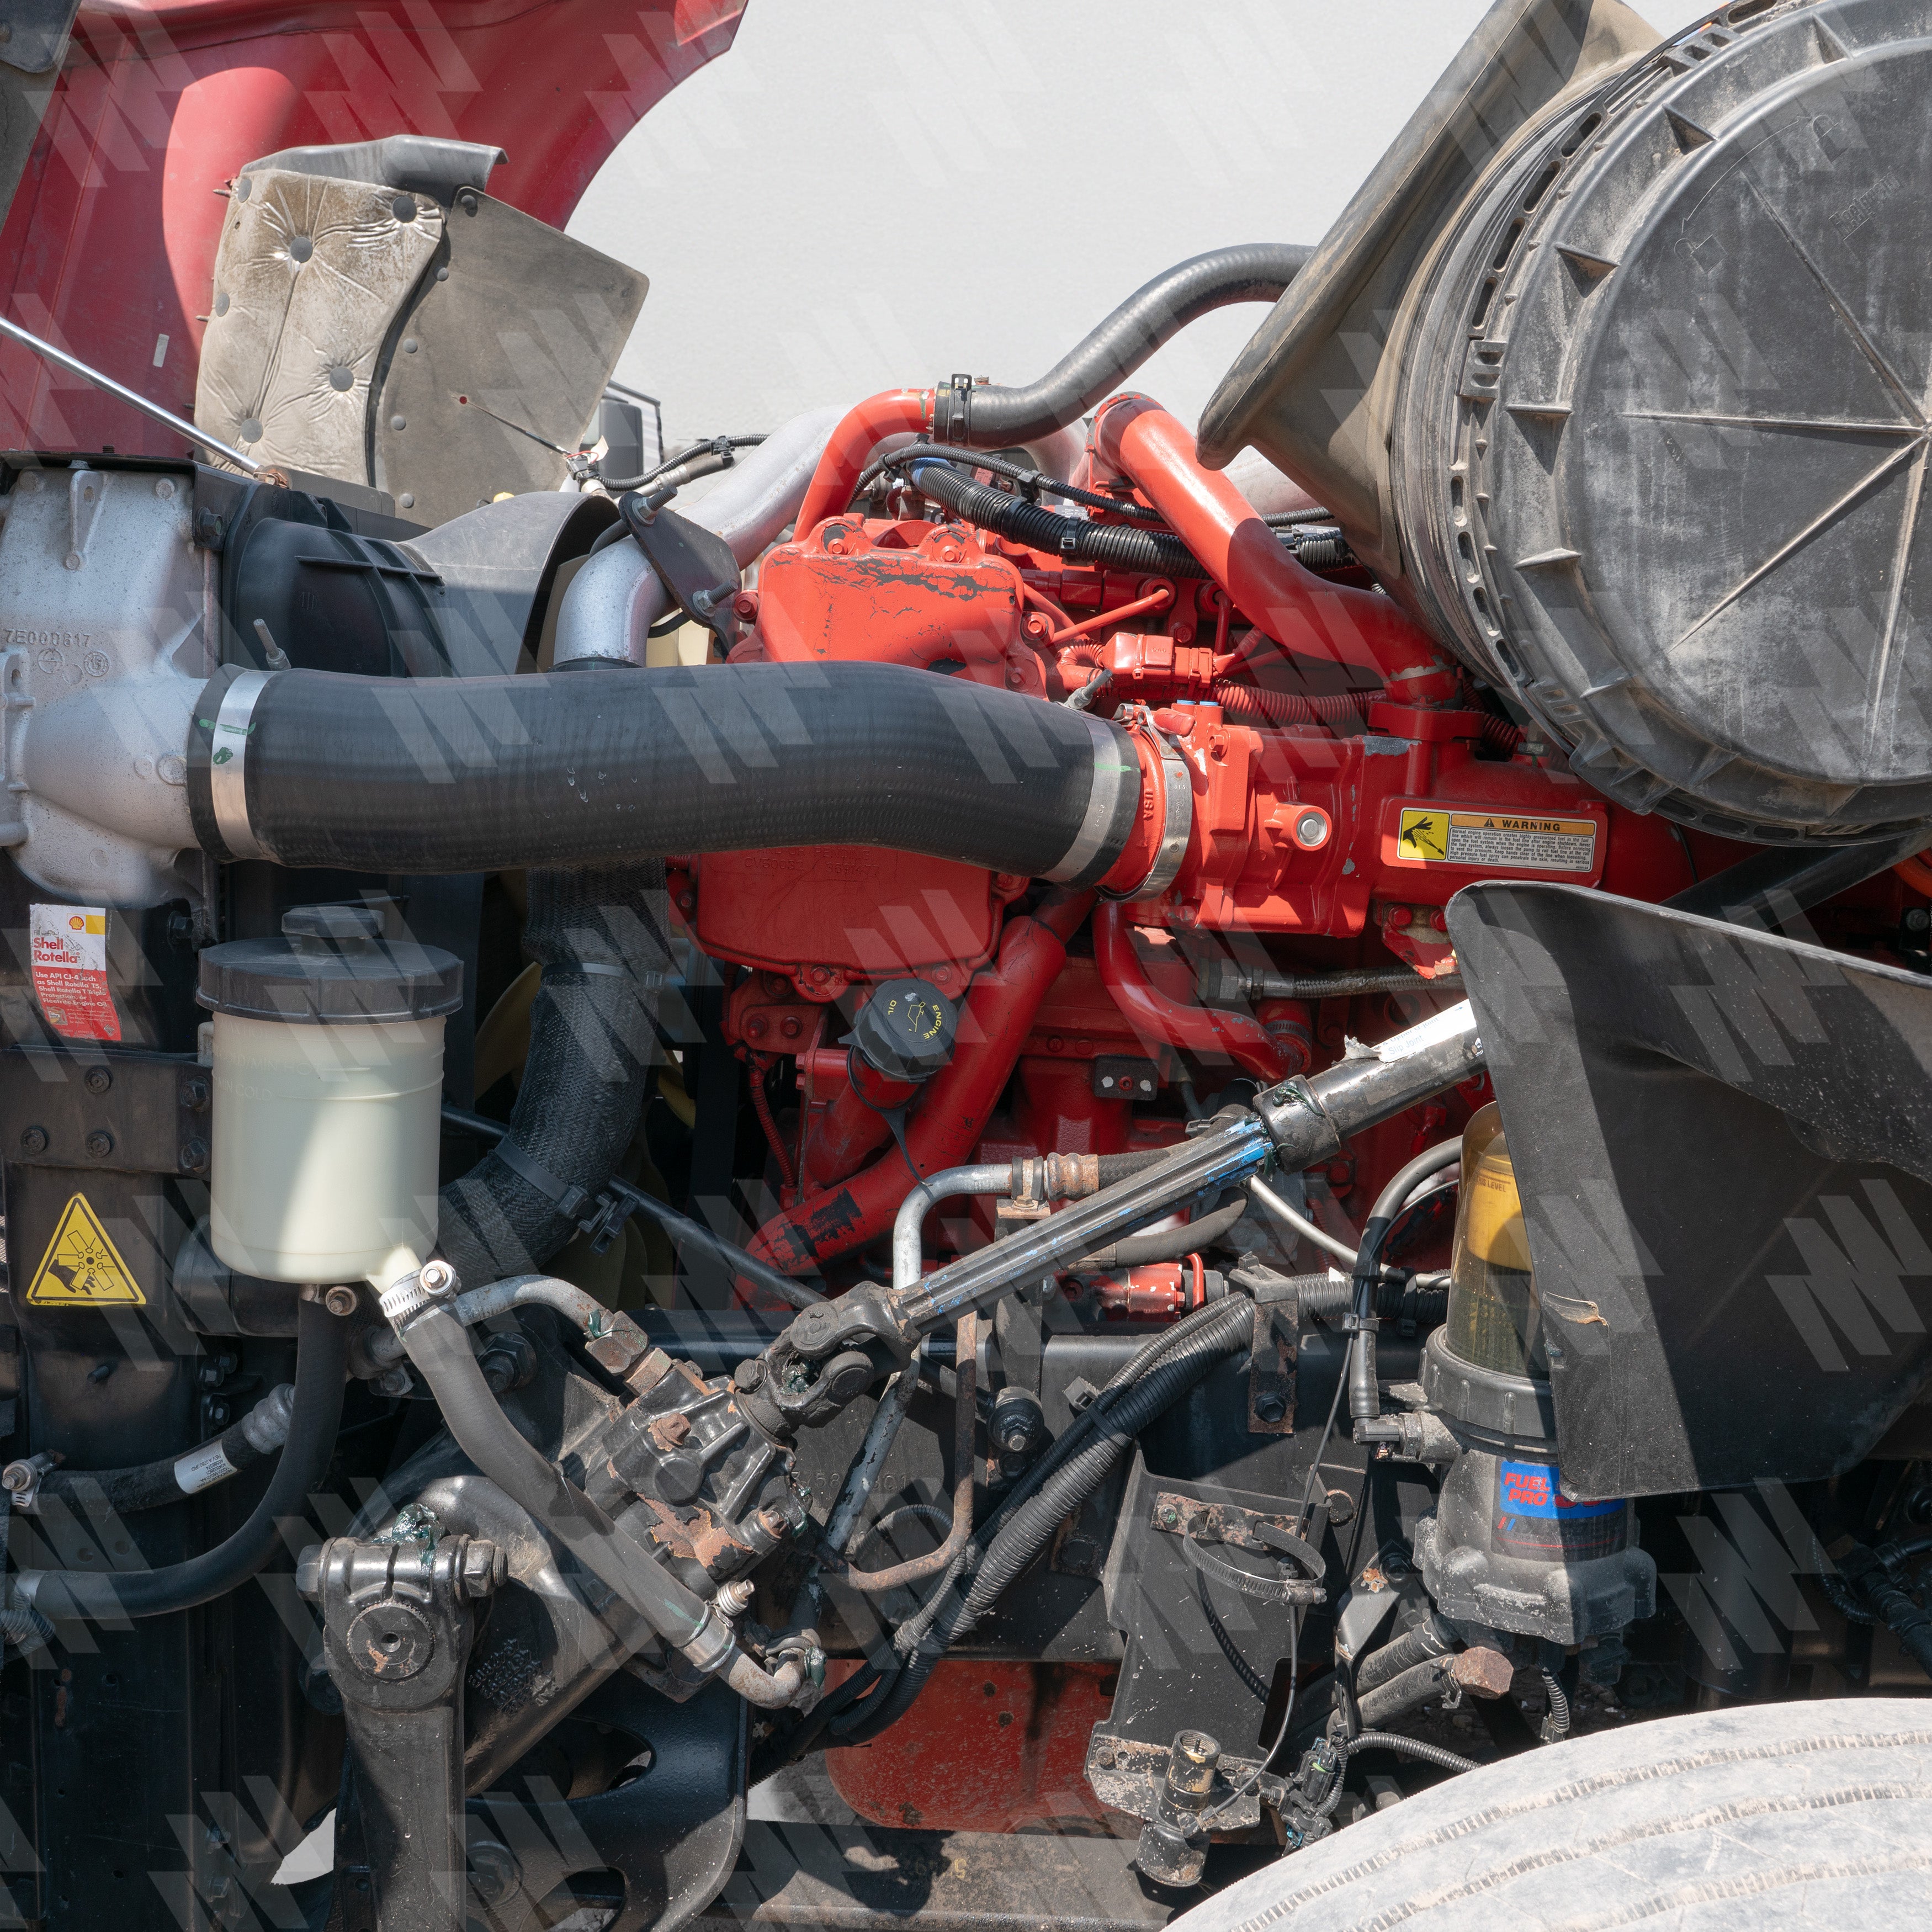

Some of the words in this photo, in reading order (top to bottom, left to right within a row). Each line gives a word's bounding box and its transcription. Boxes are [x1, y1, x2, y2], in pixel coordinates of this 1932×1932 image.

[1143, 789, 1154, 821] USA
[1502, 820, 1561, 831] WARNING
[34, 937, 63, 950] Shell
[888, 1000, 897, 1016] OIL
[922, 1004, 942, 1039] ENGINE
[1388, 1044, 1404, 1055] Slip
[1406, 1034, 1424, 1048] Joint
[1390, 1029, 1413, 1042] Upper
[235, 1082, 273, 1101] COLD
[1488, 1180, 1506, 1192] LEVEL
[1504, 1472, 1551, 1492] FUEL
[1508, 1488, 1549, 1506] PRO
